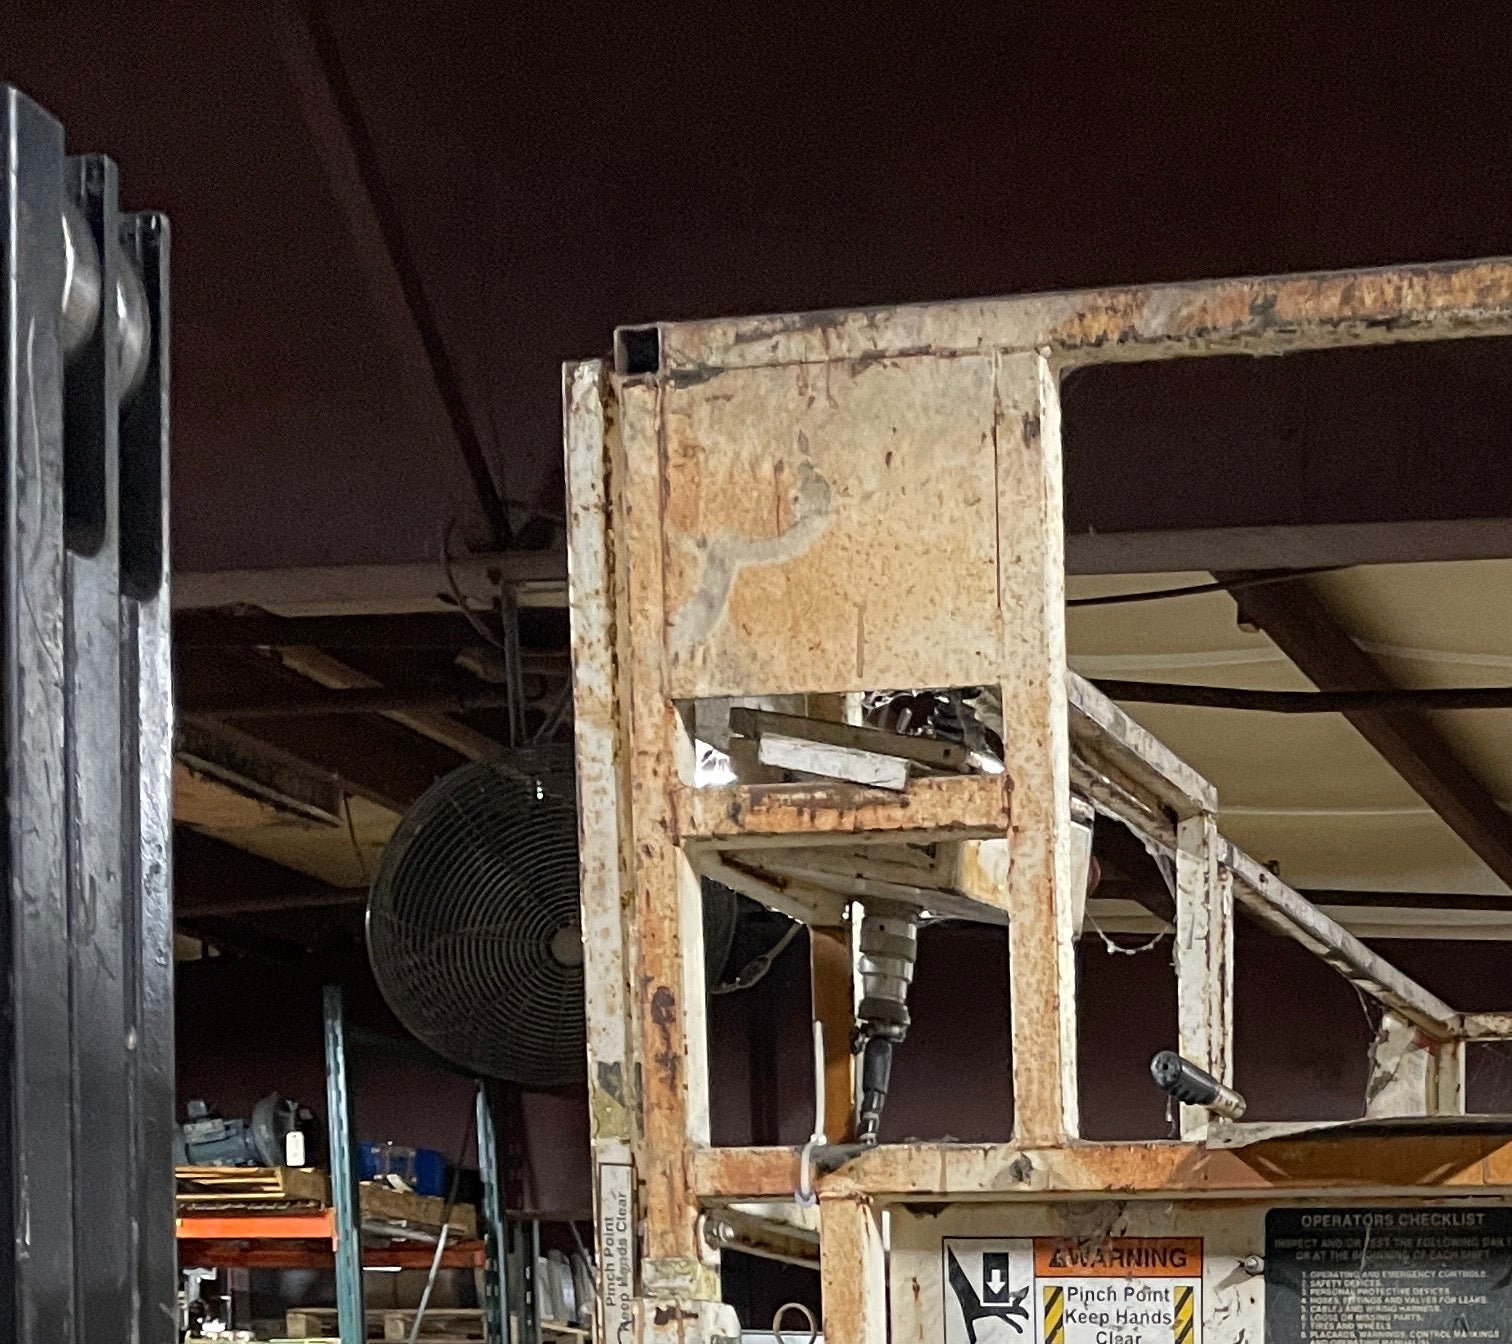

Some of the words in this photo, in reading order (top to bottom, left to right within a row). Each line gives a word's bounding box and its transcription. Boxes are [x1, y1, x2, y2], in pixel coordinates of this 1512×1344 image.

[616, 1191, 627, 1232] Clear
[1301, 1214, 1394, 1228] OPERATORS
[1399, 1213, 1487, 1227] CHECKLIST
[604, 1216, 614, 1258] Point
[1067, 1246, 1188, 1268] WARNING
[606, 1259, 616, 1306] Pinch
[1067, 1286, 1117, 1302] Pinch
[1124, 1286, 1170, 1302] Point
[1065, 1309, 1110, 1327] Keep
[1116, 1308, 1172, 1325] Hands
